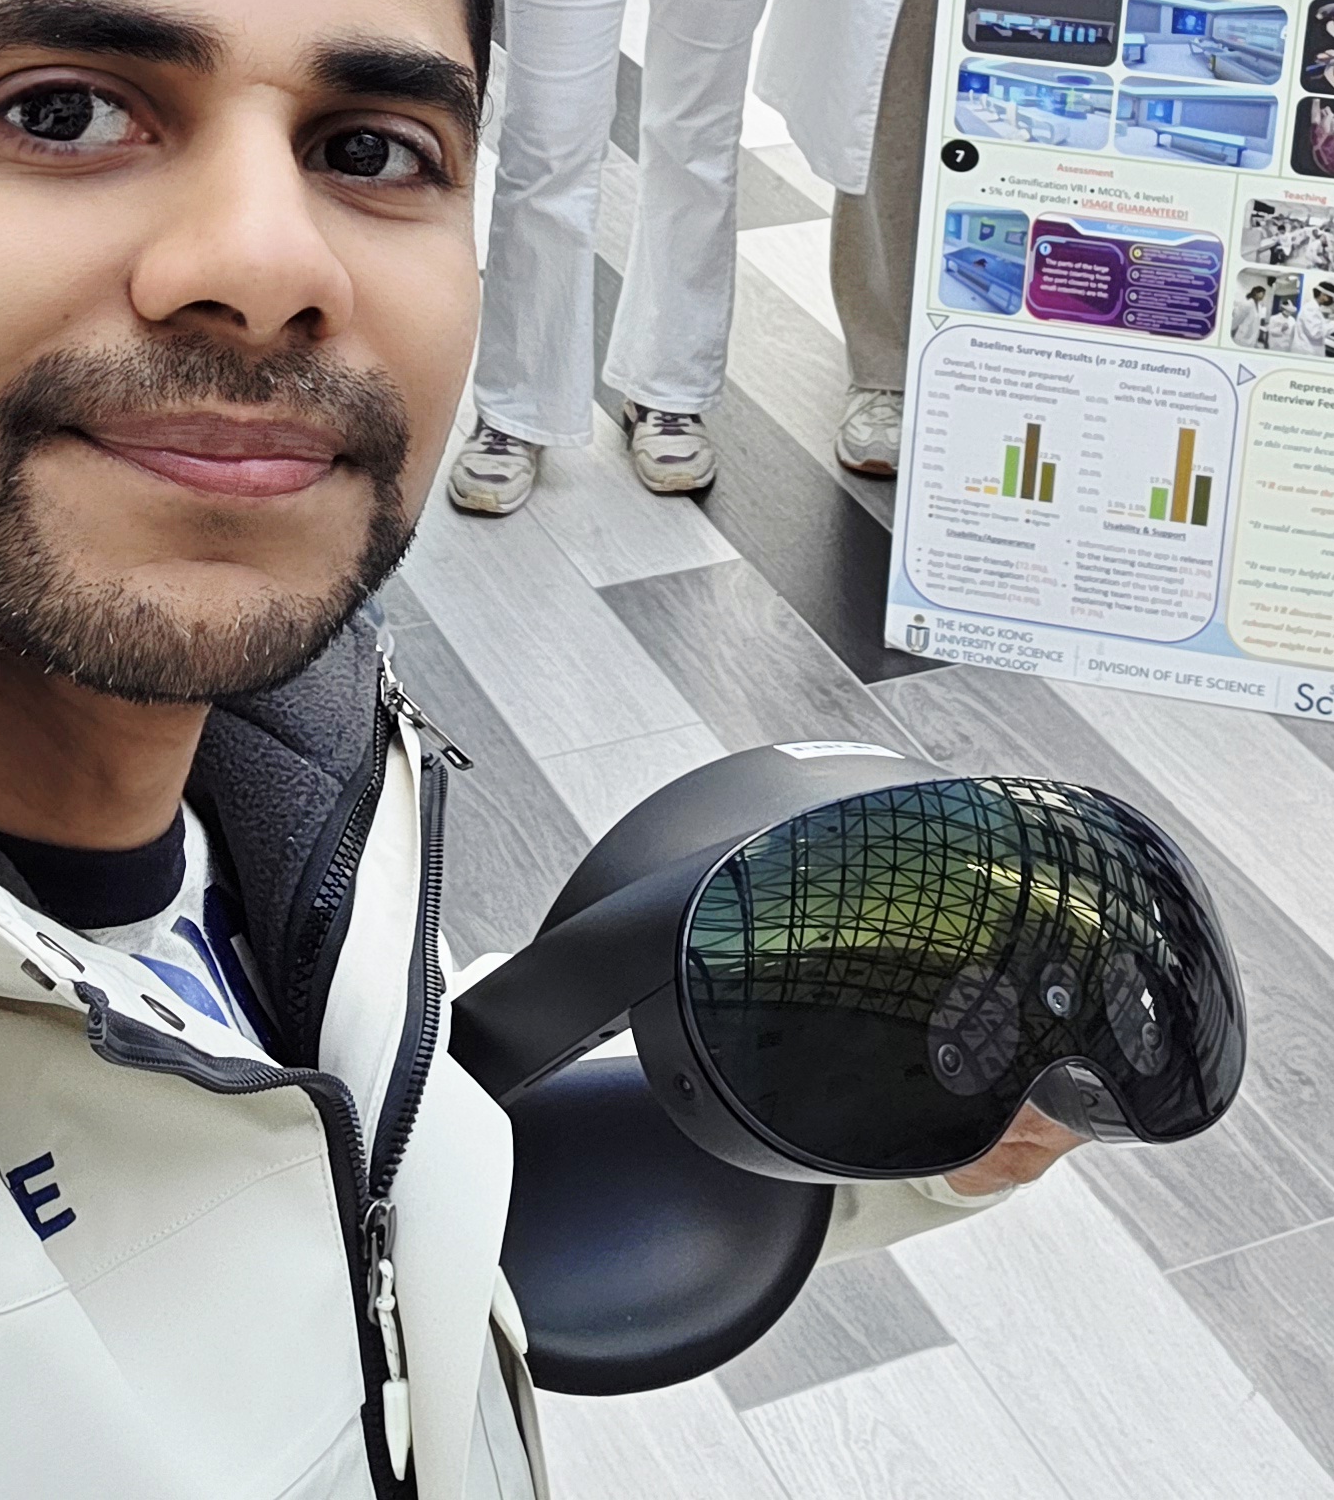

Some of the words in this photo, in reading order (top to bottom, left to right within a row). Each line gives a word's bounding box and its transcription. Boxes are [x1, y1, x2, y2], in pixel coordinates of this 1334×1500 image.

[955, 151, 965, 162] 7
[1056, 163, 1113, 178] Assessment
[1008, 175, 1068, 190] Gamification
[989, 186, 1002, 195] 5%
[1017, 189, 1037, 200] final
[1081, 198, 1113, 211] USAGE
[1283, 189, 1327, 204] Teaching
[970, 337, 1014, 352] Baseline
[1016, 344, 1052, 359] Survey
[1054, 349, 1092, 363] Results
[1117, 358, 1138, 369] 203
[1140, 363, 1190, 378] students)
[1262, 391, 1314, 406] Interview
[936, 617, 954, 630] THE
[958, 622, 994, 636] HONG
[997, 628, 1033, 642] KONG
[934, 647, 961, 662] AND
[961, 650, 1037, 670] TECHNOLOGY
[935, 632, 995, 651] UNIVERSITY
[998, 642, 1013, 653] OF
[1017, 645, 1064, 664] SCIENCE
[1088, 658, 1149, 678] DIVISION
[1152, 669, 1171, 680] OF
[1175, 672, 1202, 686] LIFE
[1206, 677, 1264, 696] SCIENCE
